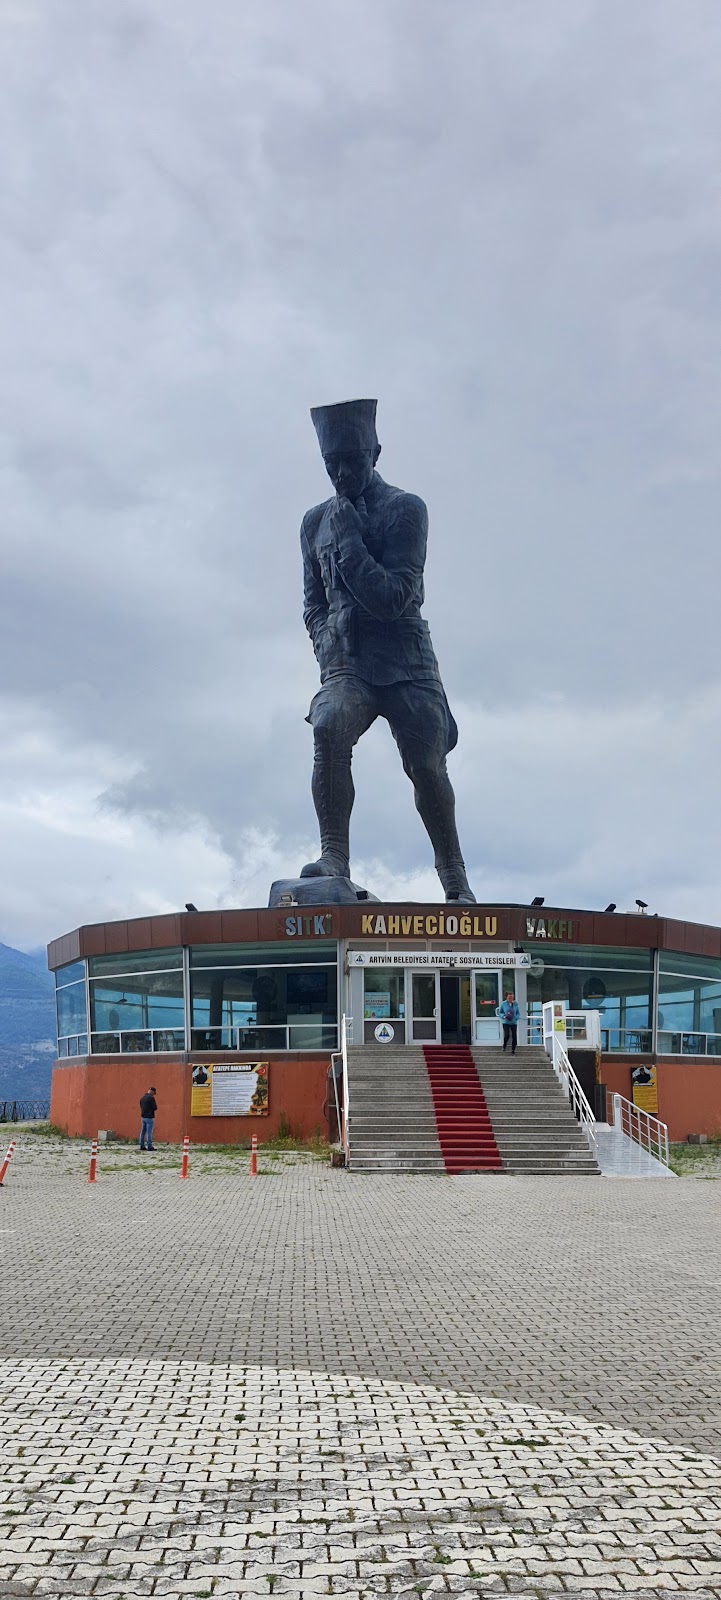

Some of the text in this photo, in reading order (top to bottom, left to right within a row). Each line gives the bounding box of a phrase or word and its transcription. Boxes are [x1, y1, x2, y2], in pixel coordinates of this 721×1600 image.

[361, 911, 497, 936] KAHVECİOĞLU
[526, 917, 573, 940] VAKFI
[369, 955, 517, 965] ARTVİN BELEDİYESİ ATATEPE SOSYAL TESİSLERİ
